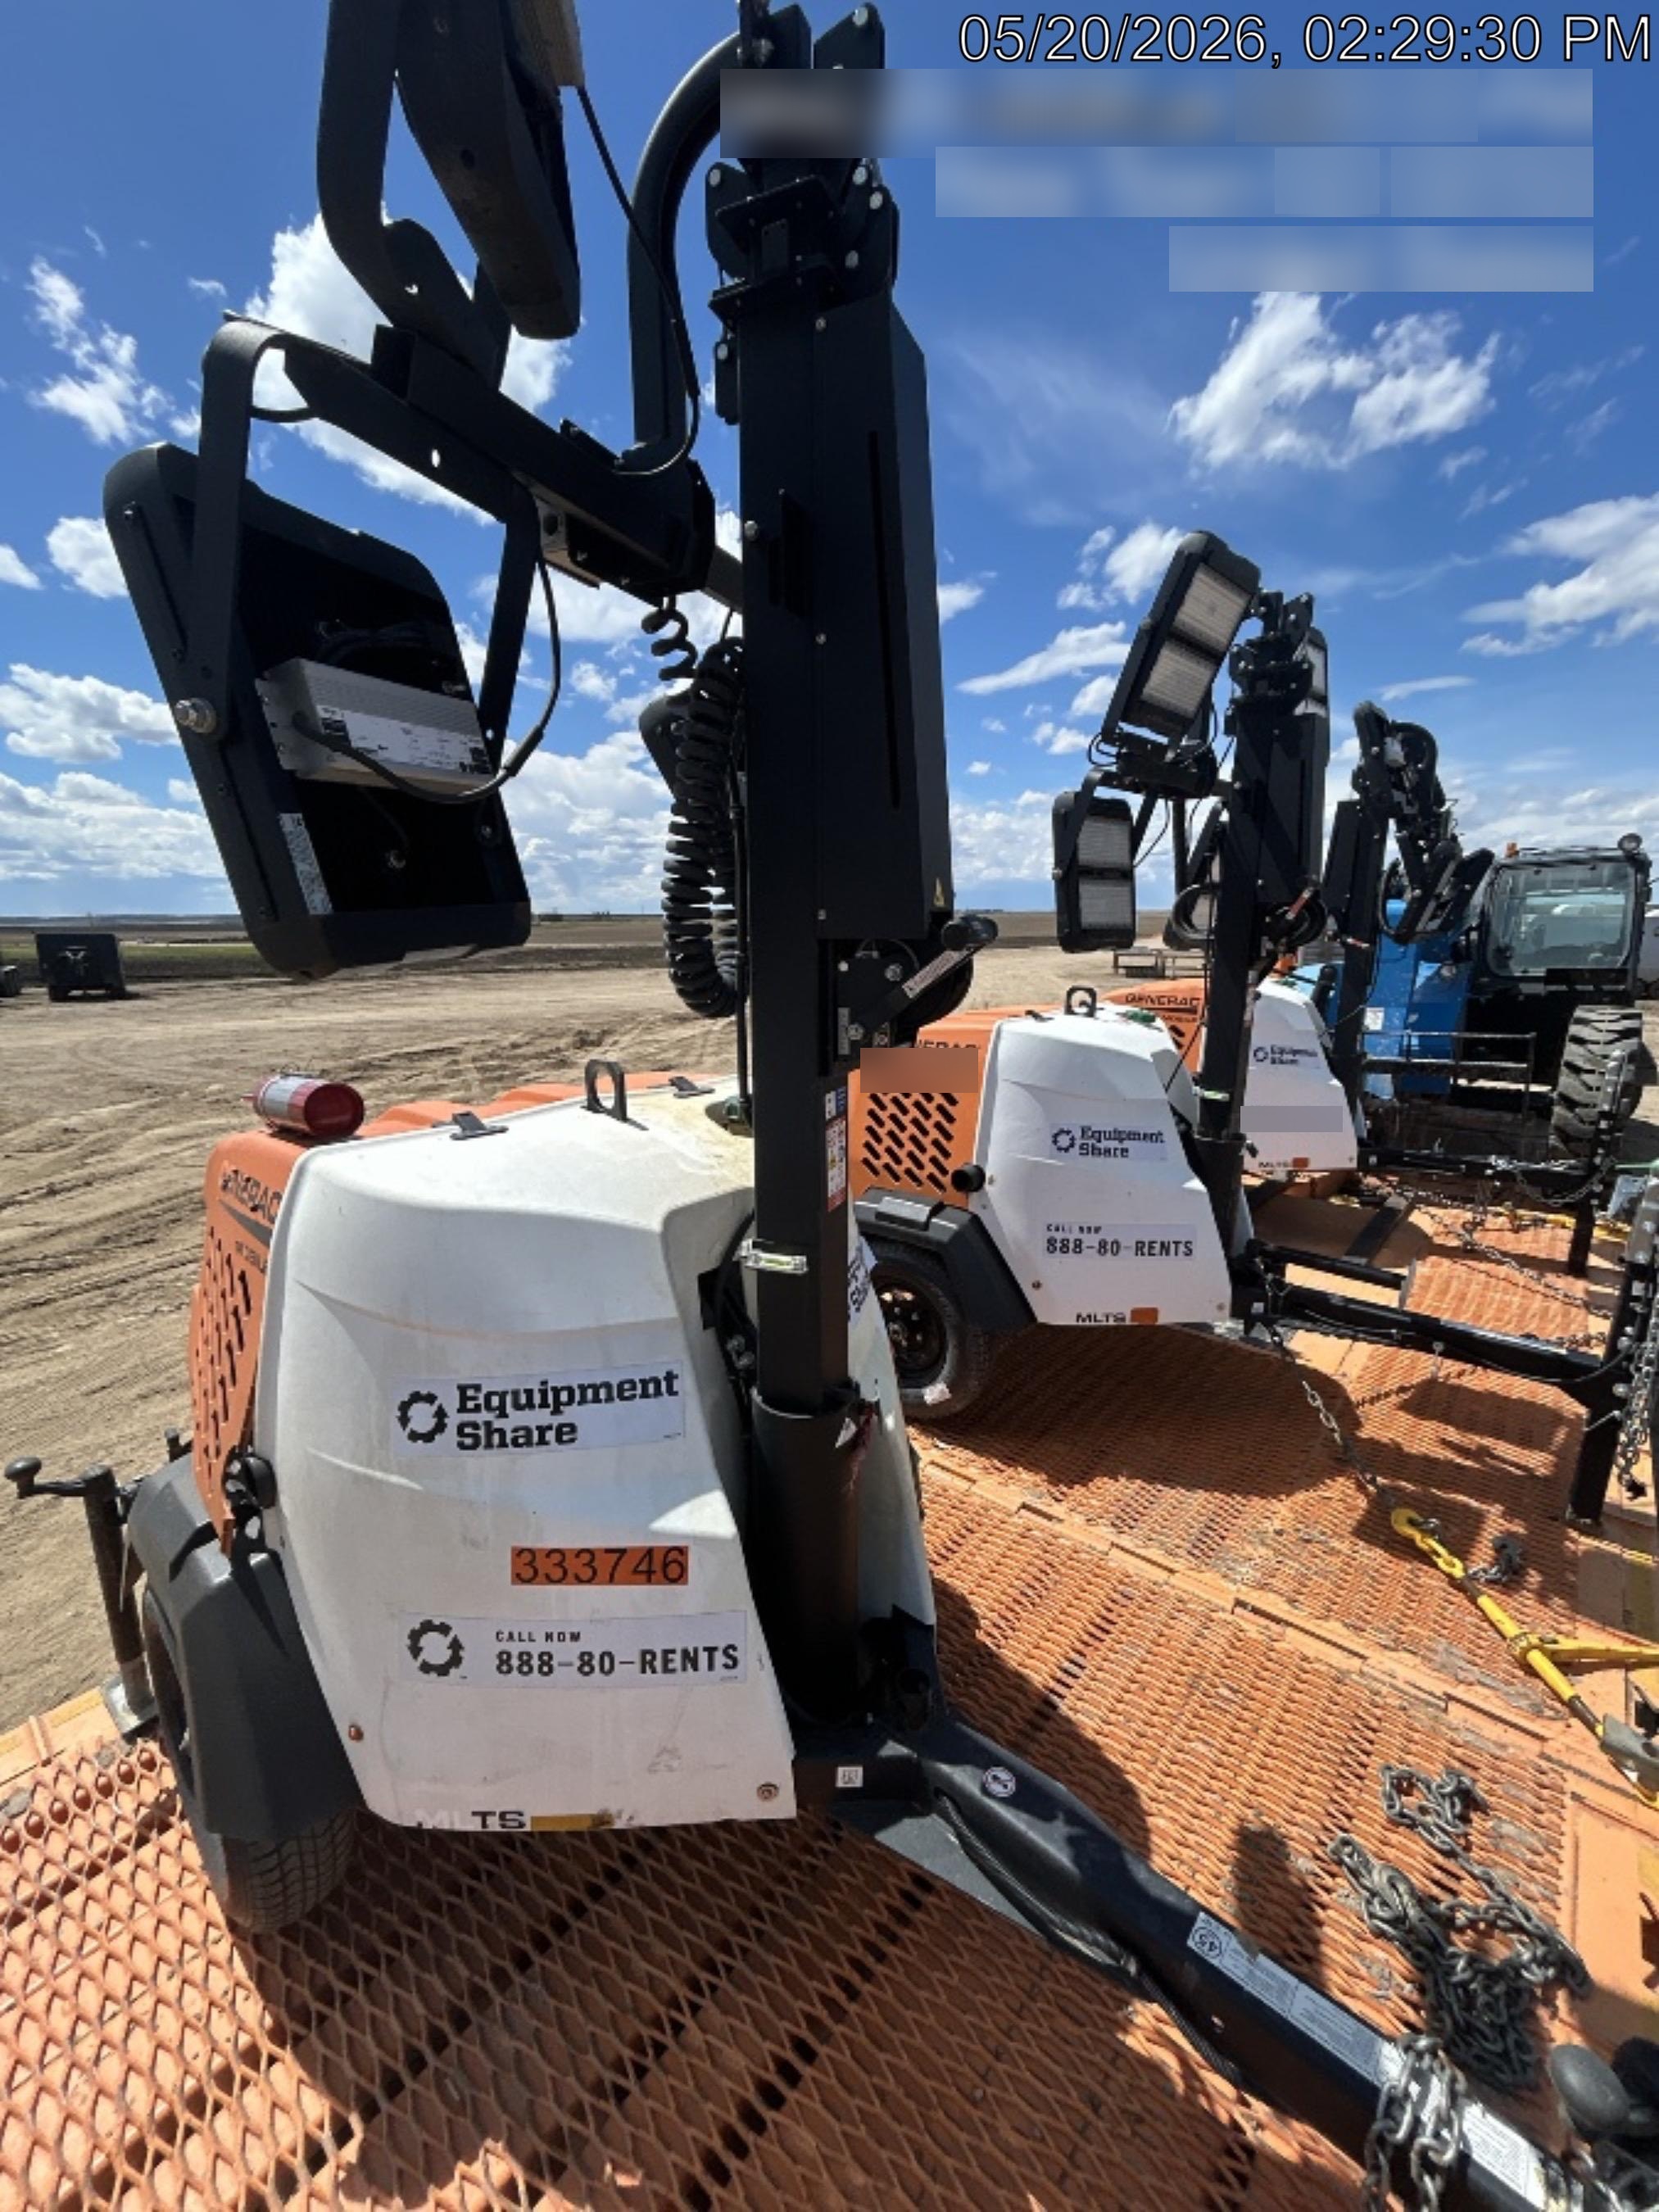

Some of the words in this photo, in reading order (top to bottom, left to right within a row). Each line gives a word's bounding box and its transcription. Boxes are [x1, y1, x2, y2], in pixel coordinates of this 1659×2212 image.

[1081, 1126, 1165, 1144] Equipment
[1079, 1142, 1129, 1158] Share
[1046, 1236, 1194, 1256] 888-80-RENTS
[1076, 1312, 1126, 1323] MLTS
[456, 1369, 679, 1418] Equipment
[456, 1420, 578, 1451] Share
[514, 1546, 686, 1583] 333746
[495, 1631, 537, 1643] CALL
[544, 1631, 581, 1642] NOW
[496, 1643, 738, 1676] 888-80-RENTS
